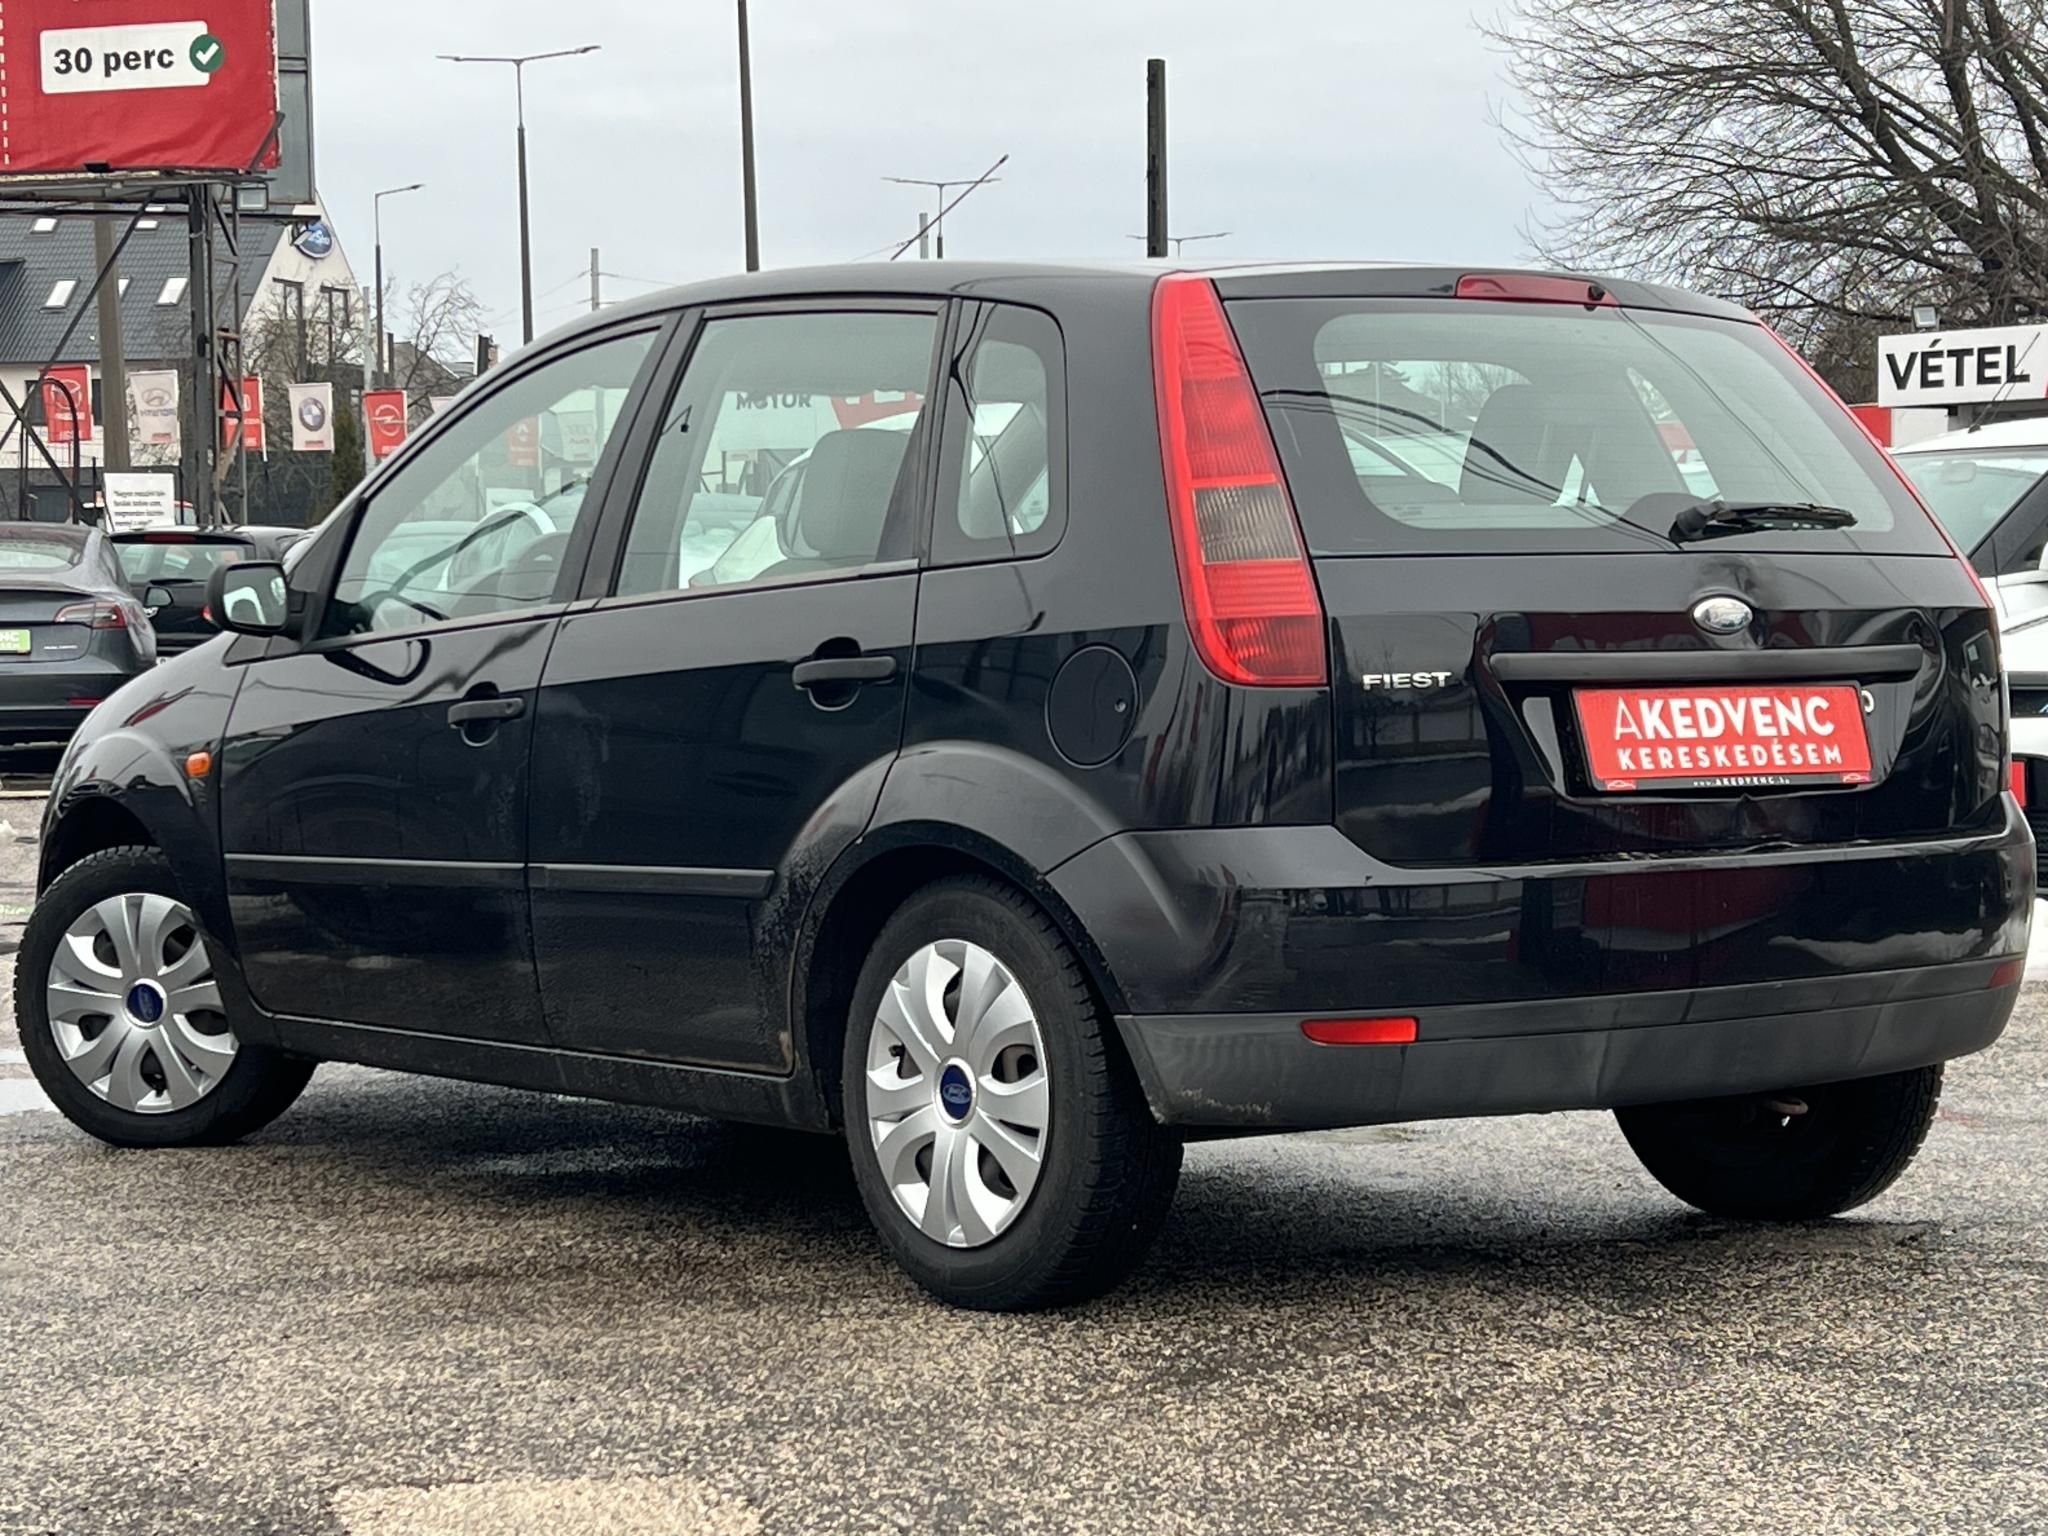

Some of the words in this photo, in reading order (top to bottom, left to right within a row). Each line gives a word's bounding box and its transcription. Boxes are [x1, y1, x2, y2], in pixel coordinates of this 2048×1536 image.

[54, 47, 93, 75] 30
[103, 47, 175, 77] perc
[1886, 338, 2030, 391] VÉTEL
[1362, 671, 1452, 691] FIEST
[1614, 695, 1836, 741] AKEDVENC
[1617, 738, 1843, 771] KERESKEDÉSEM
